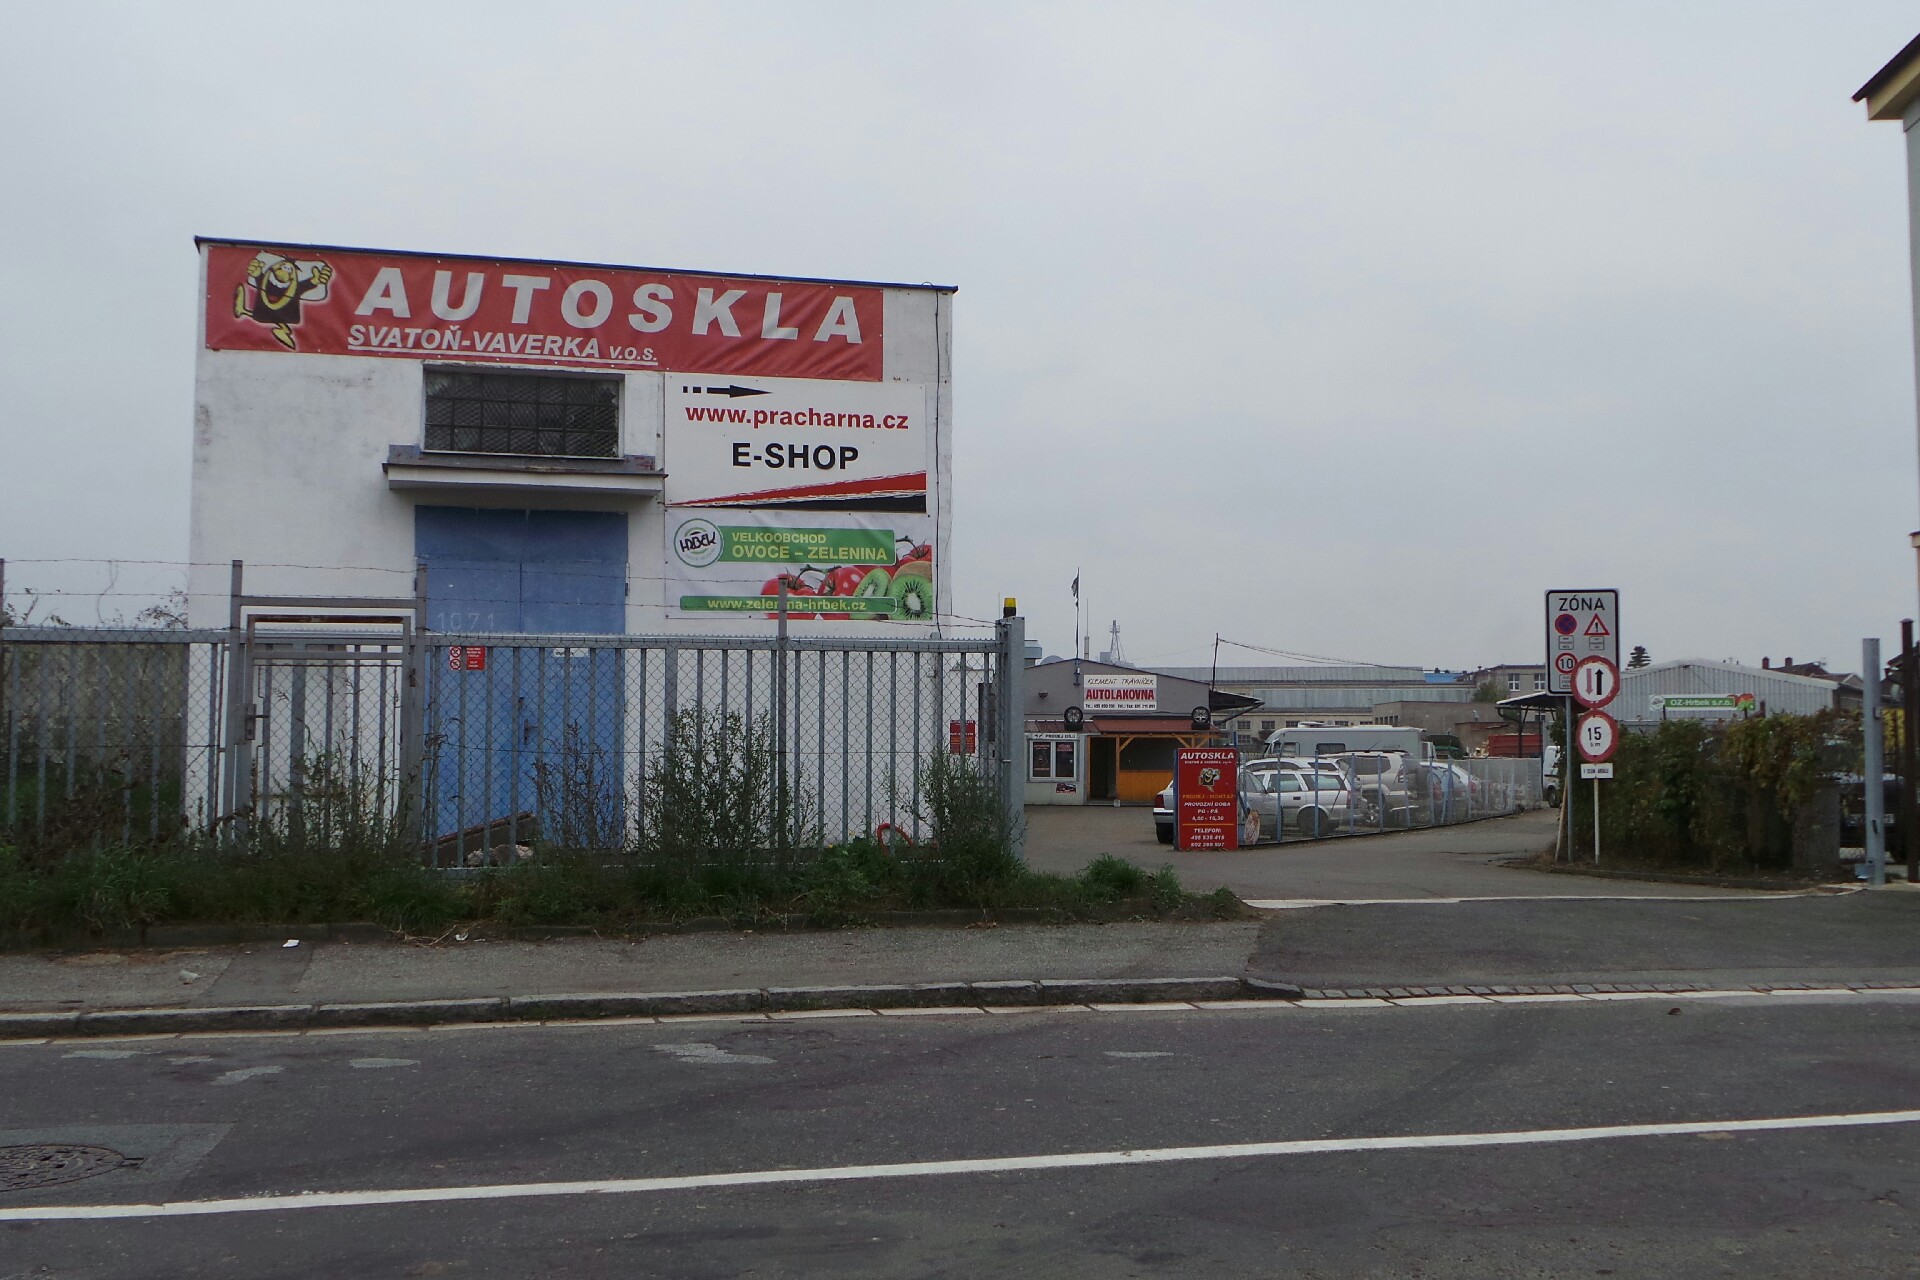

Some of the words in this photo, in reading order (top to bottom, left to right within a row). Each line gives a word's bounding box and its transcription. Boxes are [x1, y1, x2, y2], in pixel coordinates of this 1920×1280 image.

[354, 266, 863, 344] AUTOSKLA
[348, 324, 600, 358] SVATOŇ-VAVERKA
[685, 407, 909, 430] www.pracharna.cz
[732, 442, 859, 470] E-SHOP
[731, 532, 827, 544] VELKOOBCHOD
[732, 544, 790, 559] OVOCE
[807, 546, 888, 561] ZELENINA
[1558, 594, 1606, 612] ZÓNA
[1560, 657, 1574, 669] 10
[1085, 689, 1155, 700] AUTOLAKOVNA
[1670, 698, 1710, 706] OZ-Hrbek
[1587, 726, 1602, 741] 15
[1180, 752, 1234, 760] AUTOSKLA
